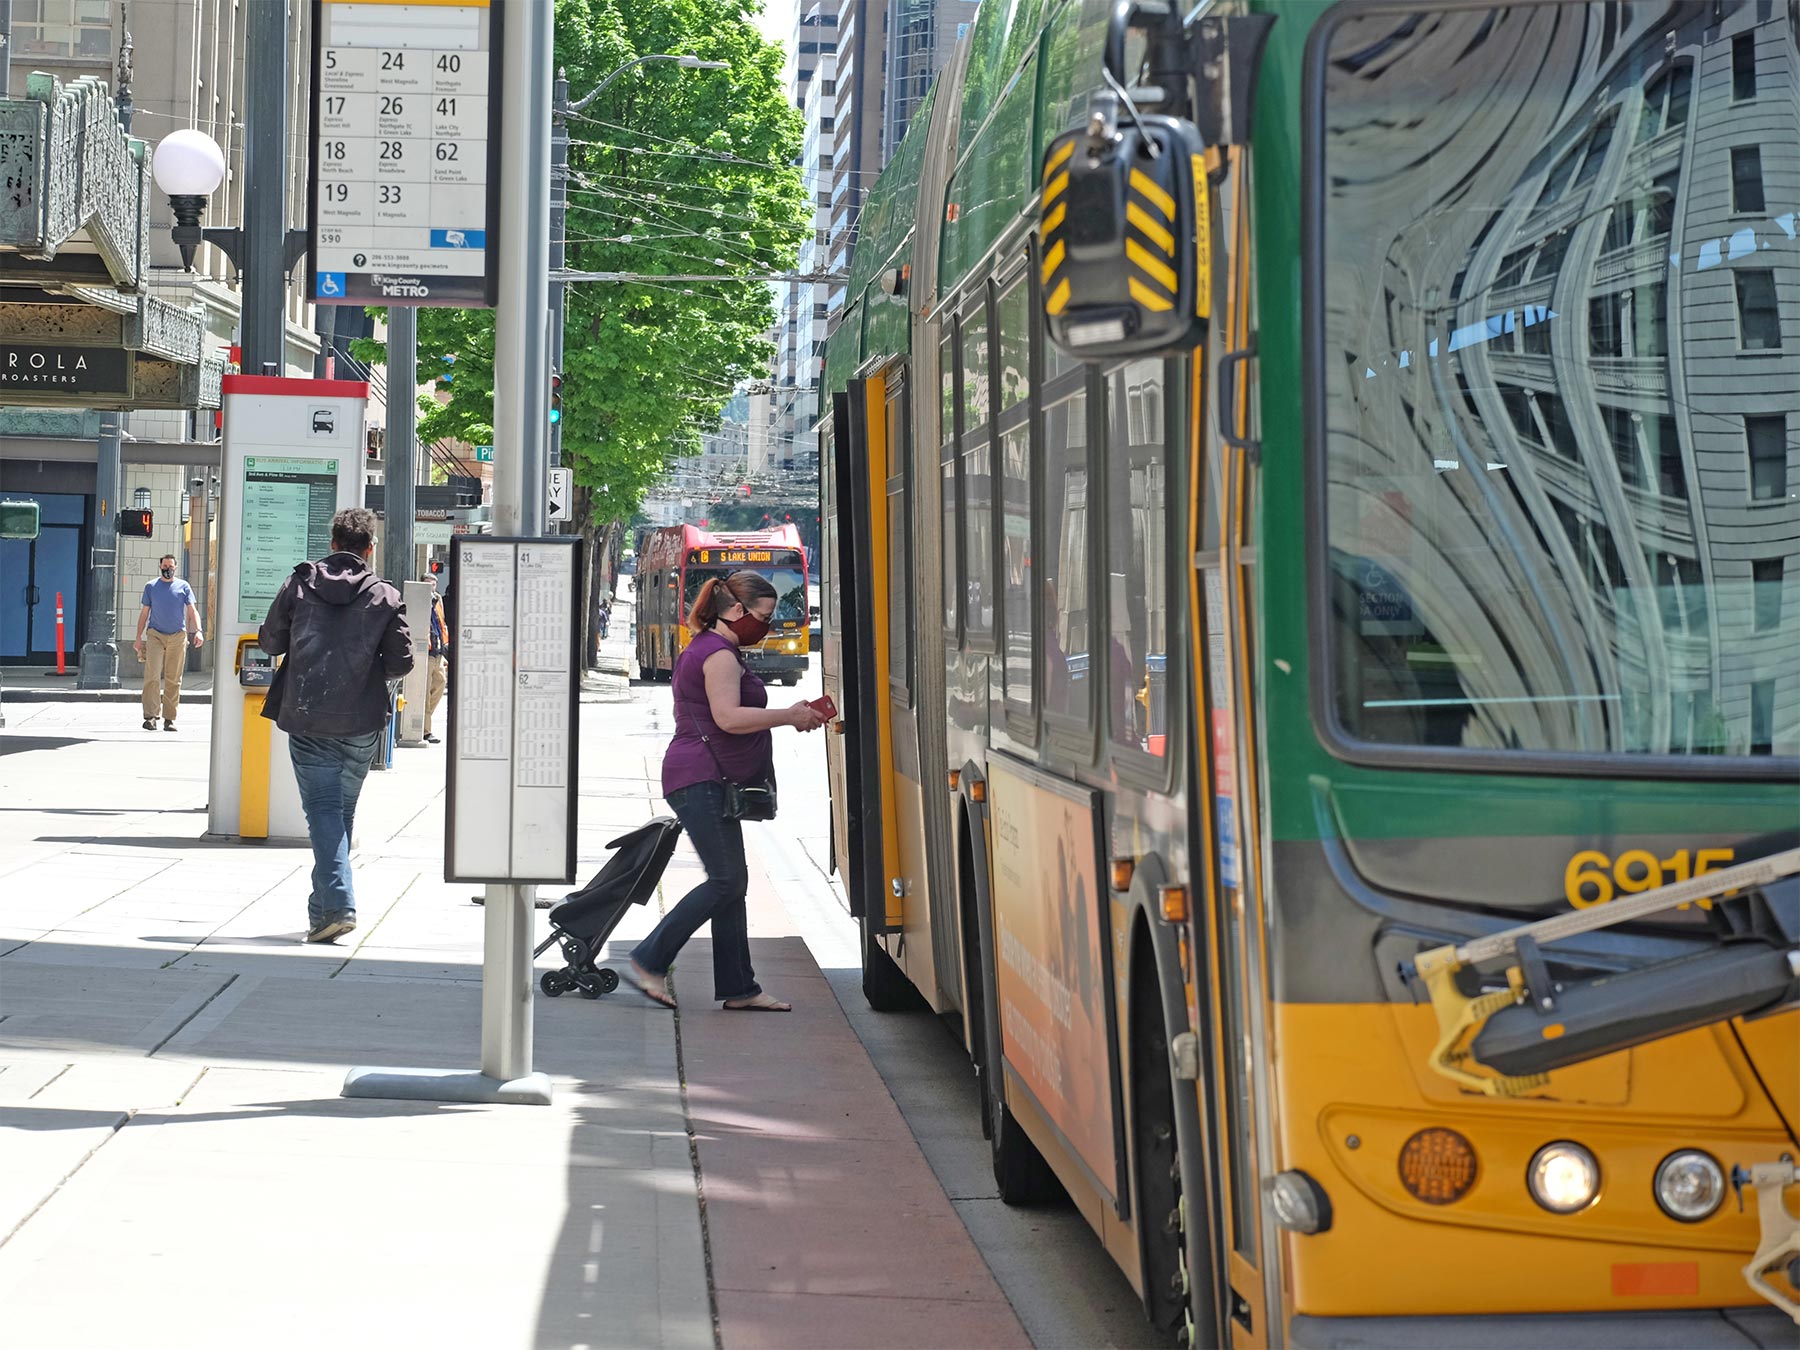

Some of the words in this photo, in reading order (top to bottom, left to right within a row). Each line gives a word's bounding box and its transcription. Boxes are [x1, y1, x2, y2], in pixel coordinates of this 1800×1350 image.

[326, 51, 336, 68] 5
[381, 52, 404, 70] 24
[436, 54, 460, 72] 40
[326, 96, 345, 115] 17
[380, 96, 403, 115] 26
[436, 98, 456, 116] 41
[325, 142, 346, 159] 18
[380, 141, 402, 159] 28
[436, 143, 458, 160] 62
[326, 184, 348, 202] 19
[379, 185, 401, 204] 33
[321, 235, 341, 243] 590
[384, 277, 399, 285] King
[399, 278, 421, 286] County
[382, 286, 429, 297] METRO
[9, 352, 87, 370] ROLA
[1, 373, 77, 383] ROASTERS
[550, 474, 560, 484] E
[142, 513, 150, 532] 4
[463, 552, 473, 562] 33
[521, 552, 530, 563] 41
[720, 552, 726, 562] S
[728, 552, 746, 562] LAKE
[748, 552, 771, 562] UNION
[462, 629, 472, 640] 40
[519, 674, 528, 684] 62
[1565, 848, 1738, 910] 6915
